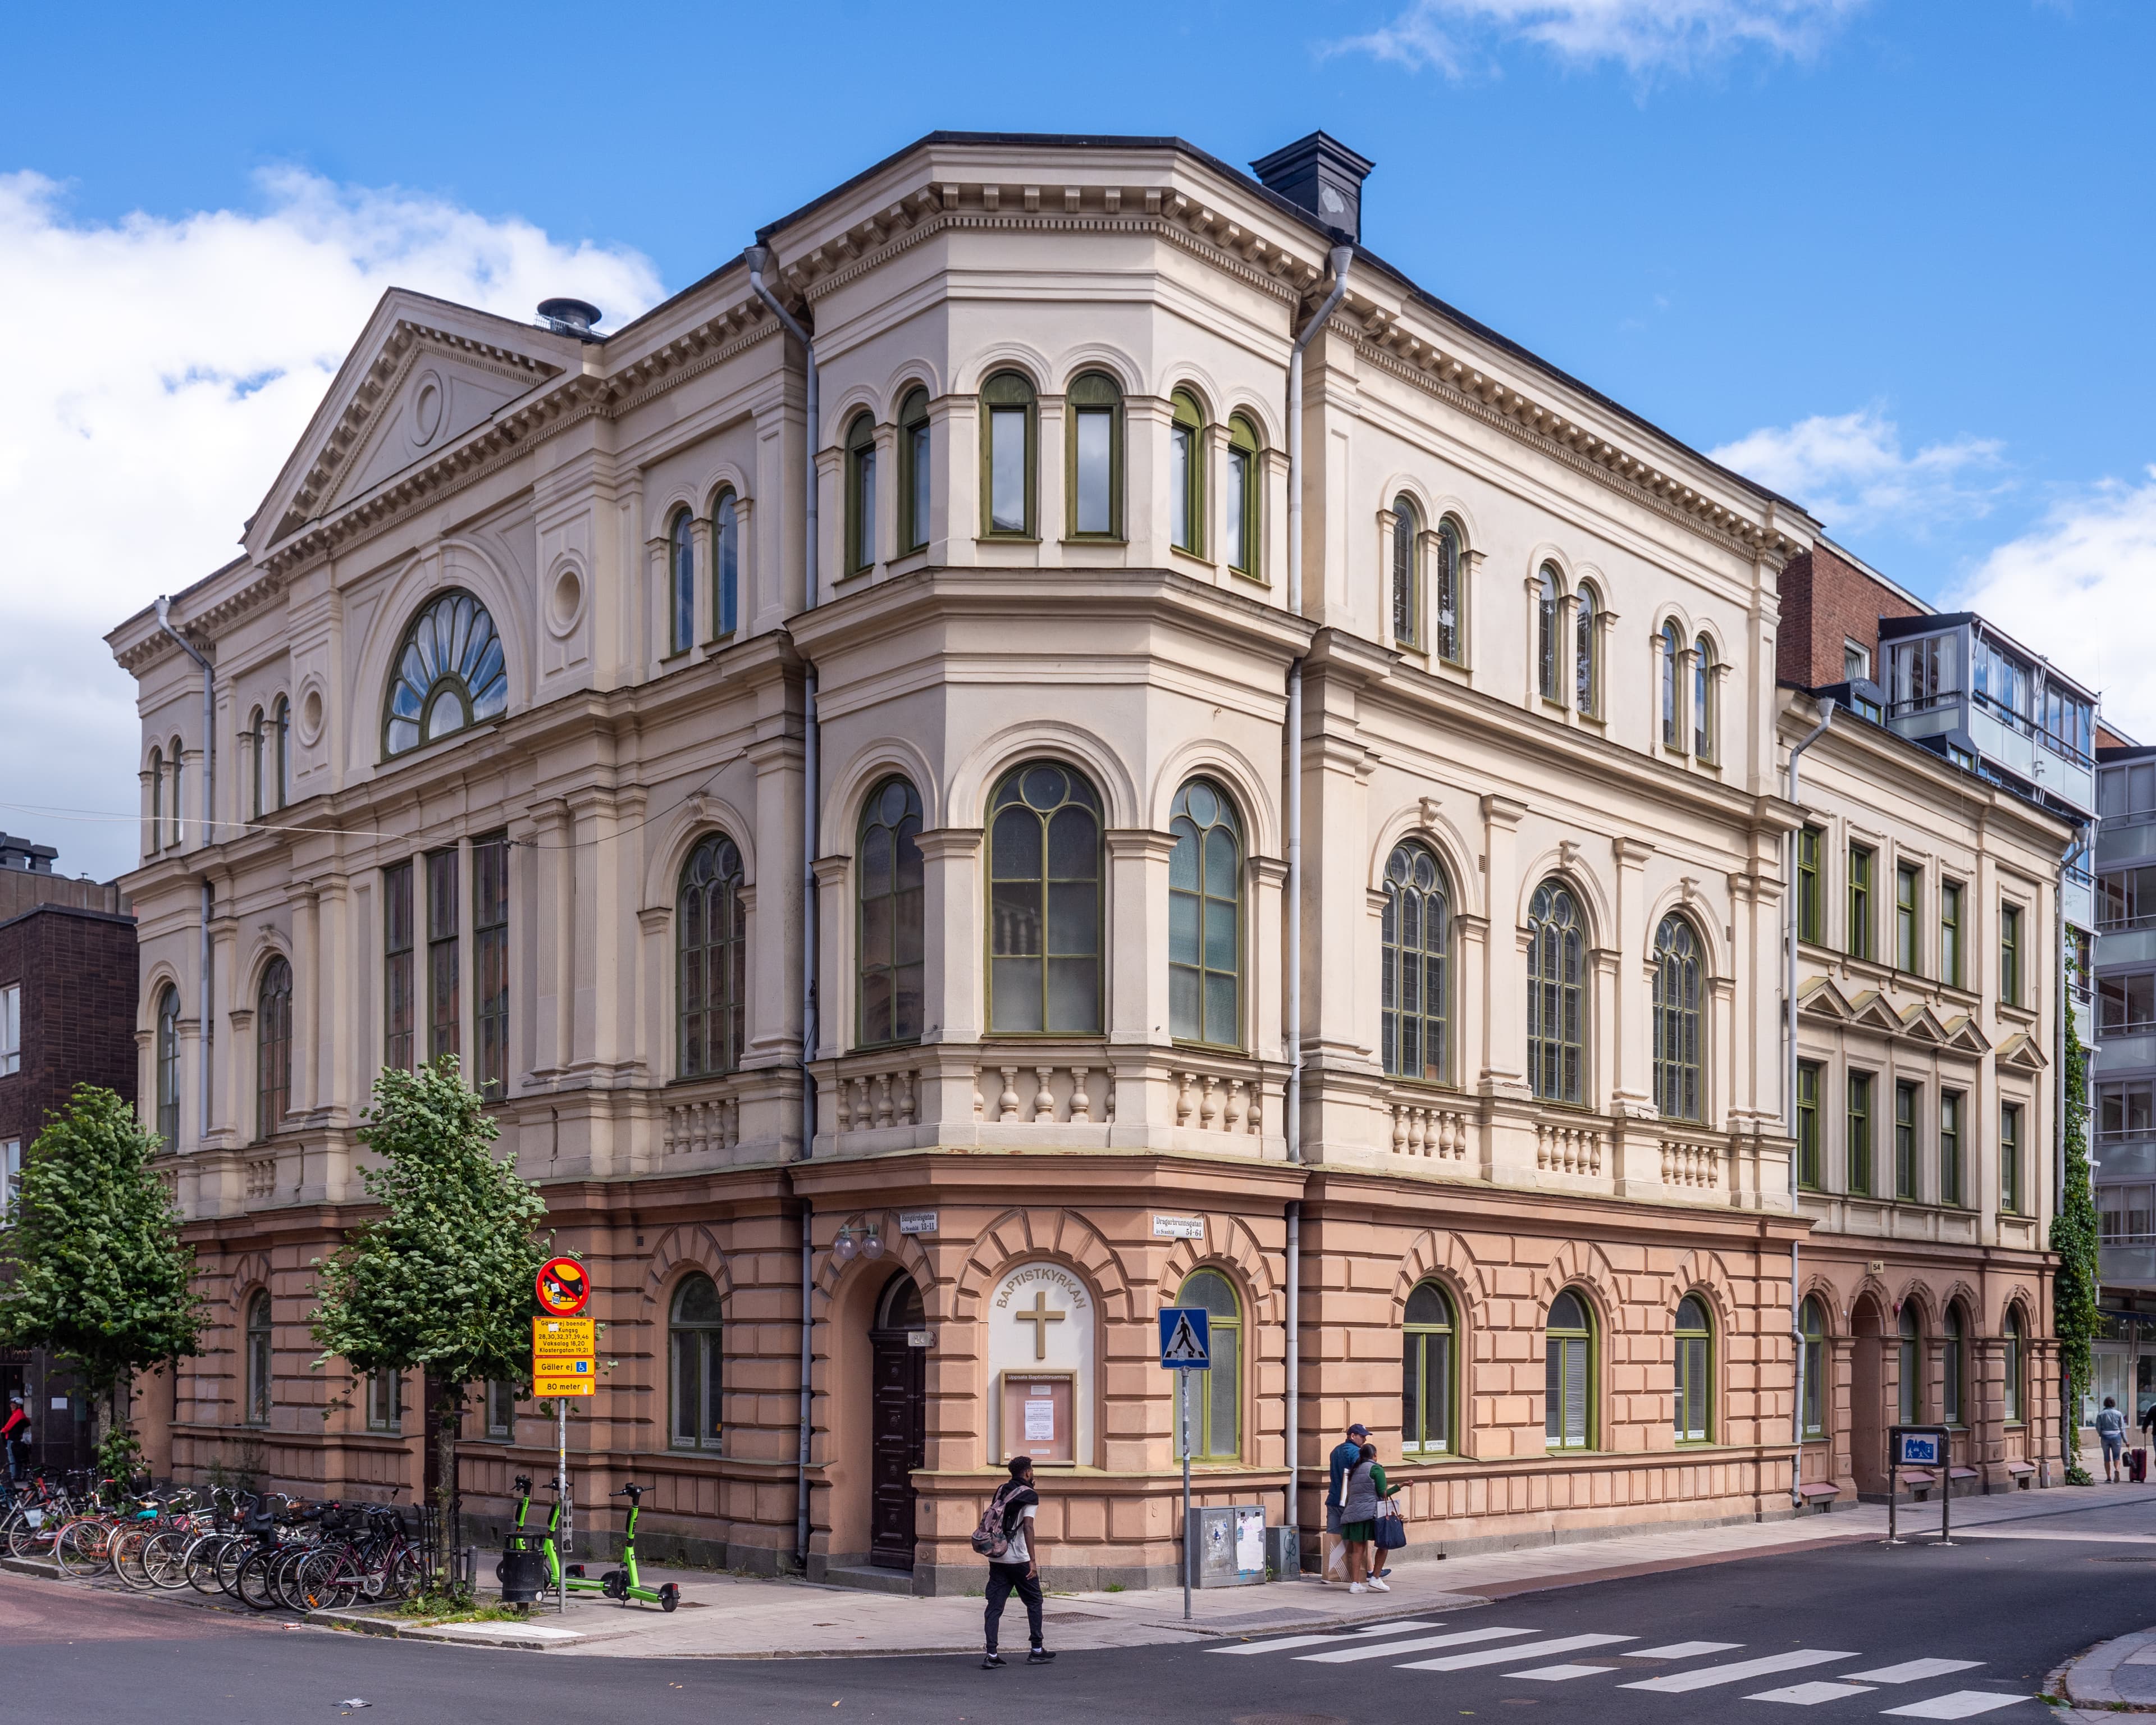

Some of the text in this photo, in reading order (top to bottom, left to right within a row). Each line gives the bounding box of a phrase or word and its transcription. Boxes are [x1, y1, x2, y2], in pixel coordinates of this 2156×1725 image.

[902, 1214, 934, 1223] Bangårdsgatan
[1156, 1217, 1202, 1227] Dragarbrunnsgatan
[996, 1268, 1087, 1309] BAPTISTKYRKAN
